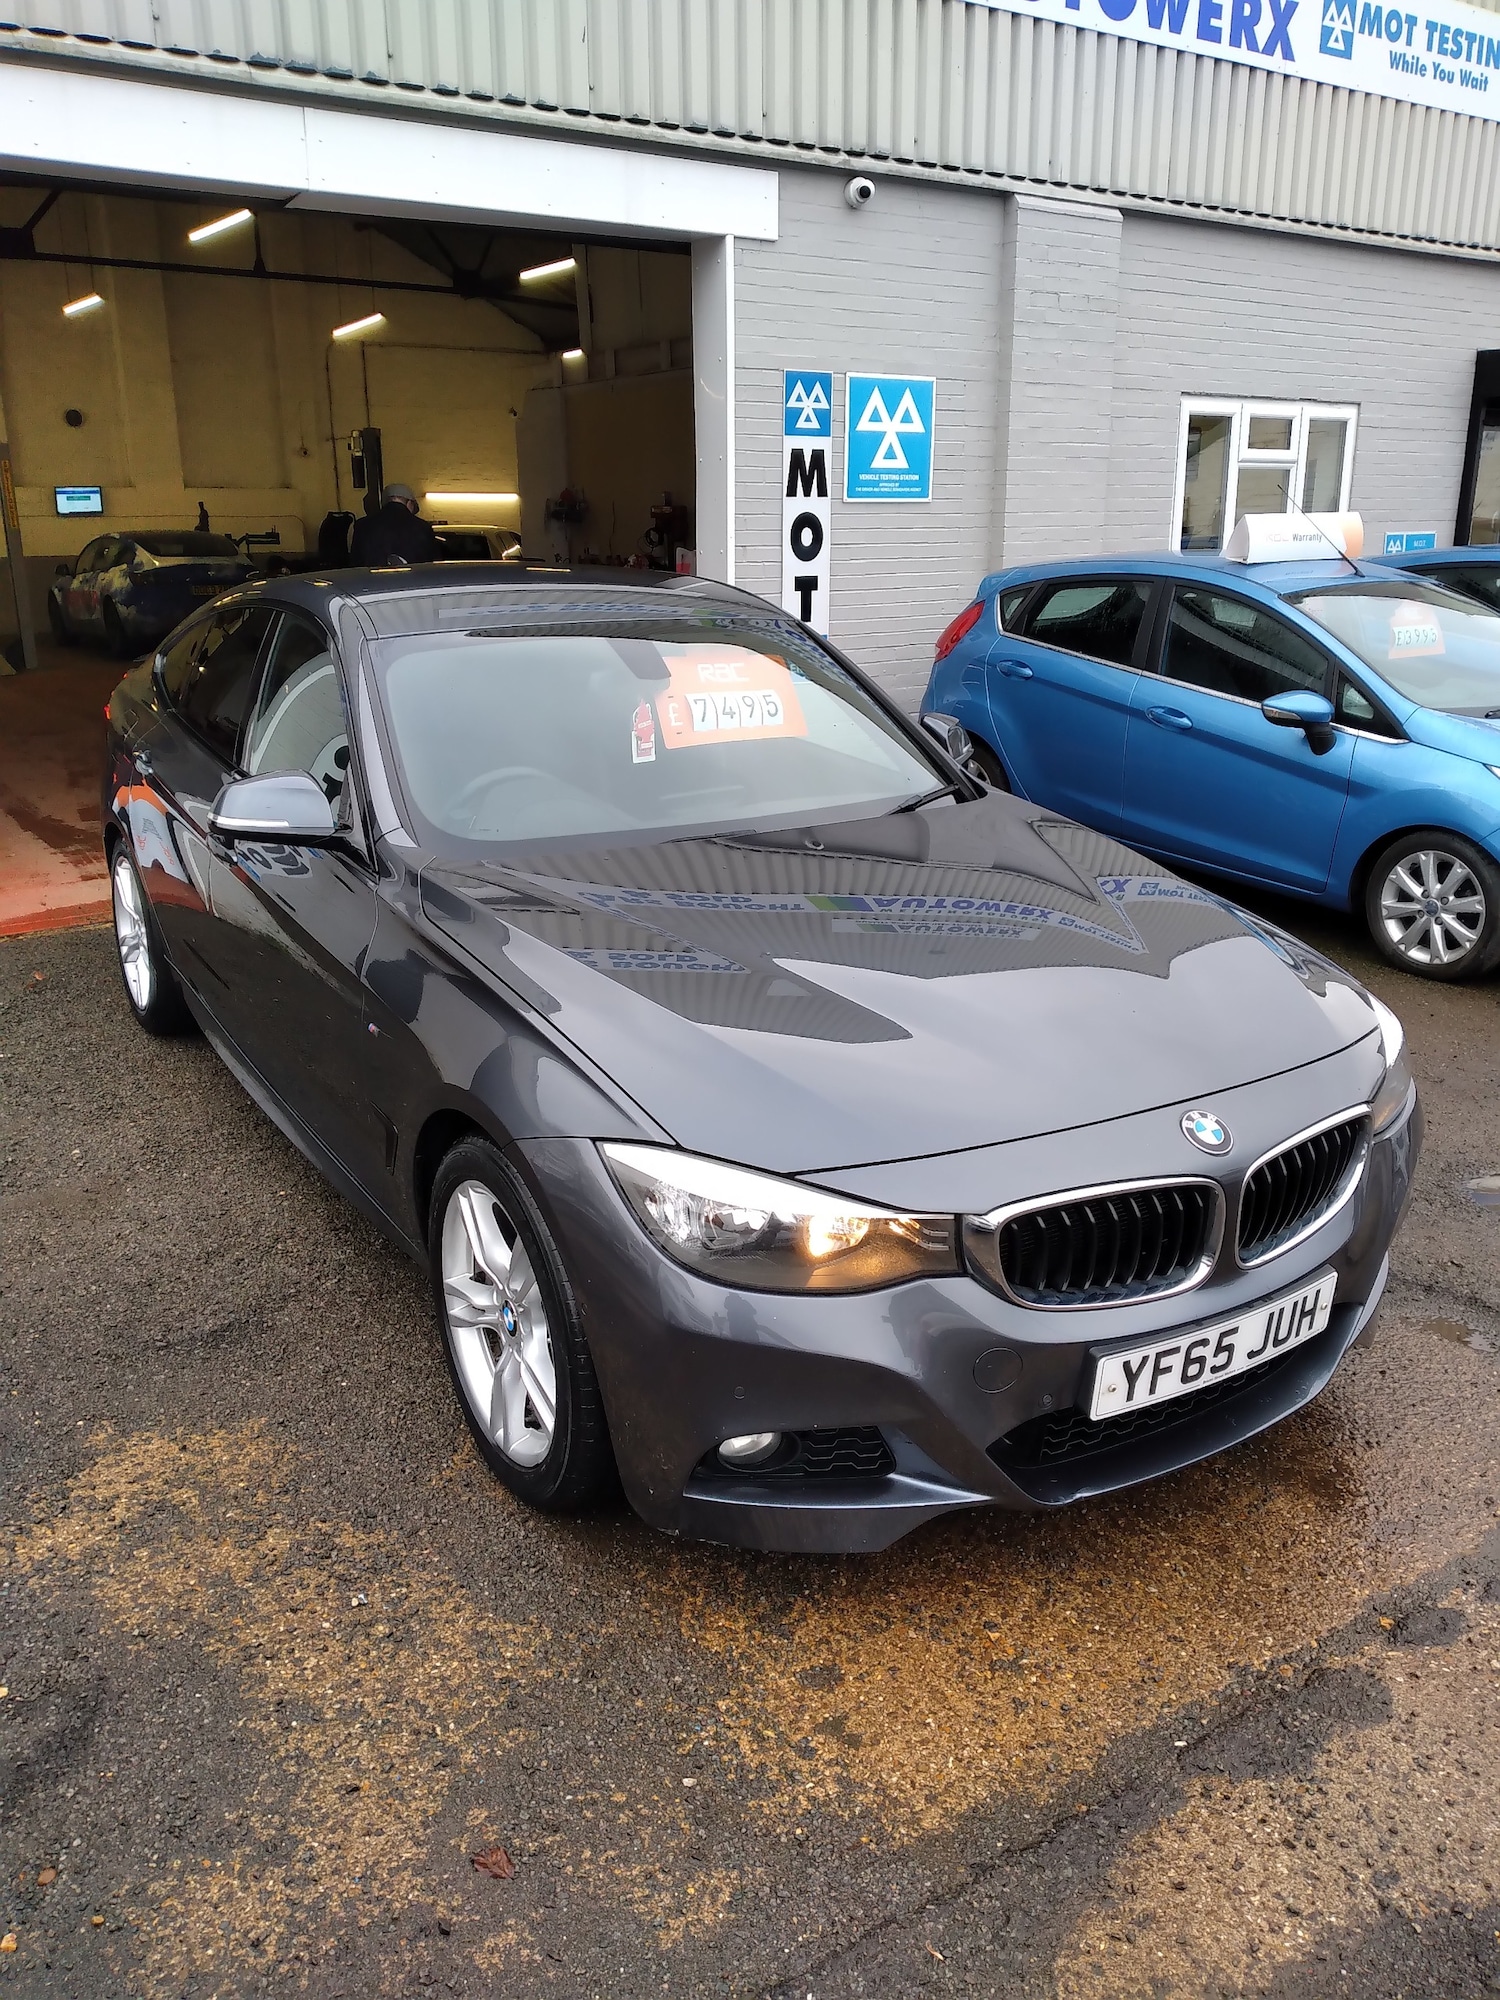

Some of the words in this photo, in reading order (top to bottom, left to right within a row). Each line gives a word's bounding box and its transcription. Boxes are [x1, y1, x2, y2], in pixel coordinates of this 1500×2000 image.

[1359, 2, 1417, 47] MOT
[1389, 50, 1427, 78] While
[1433, 61, 1455, 84] You
[1460, 69, 1488, 92] Wait
[786, 448, 829, 622] MOT
[1292, 533, 1322, 543] Warranty
[697, 662, 750, 683] RAC
[1122, 1326, 1240, 1403] YF65
[1247, 1289, 1322, 1360] JUH
